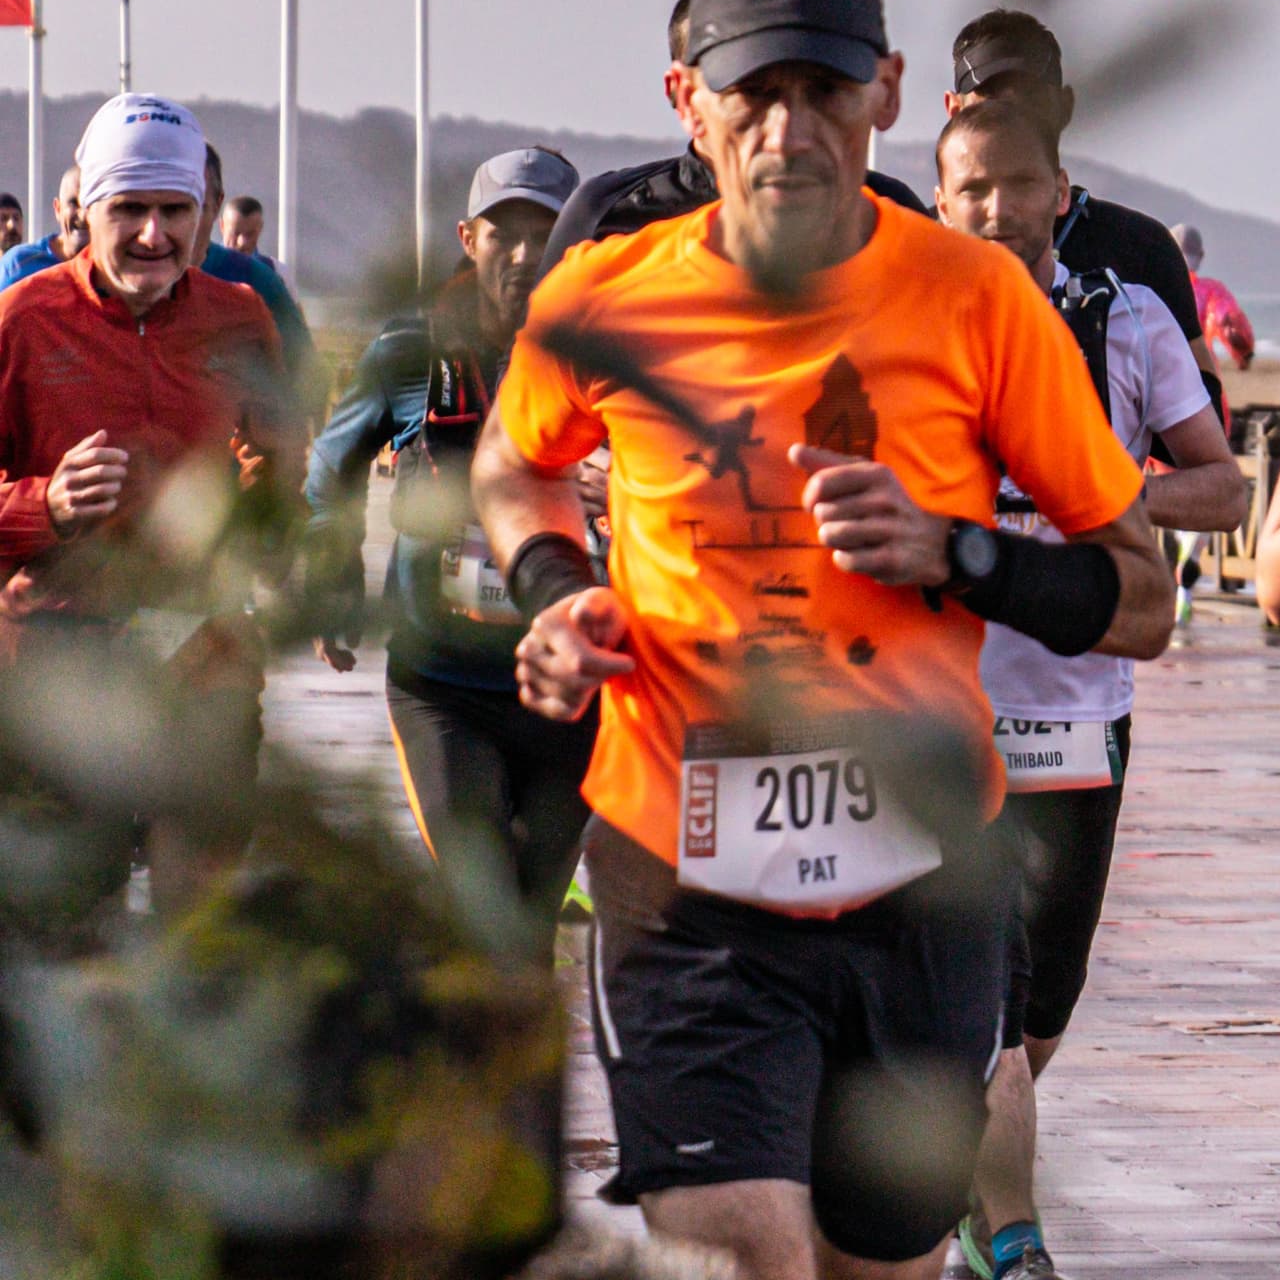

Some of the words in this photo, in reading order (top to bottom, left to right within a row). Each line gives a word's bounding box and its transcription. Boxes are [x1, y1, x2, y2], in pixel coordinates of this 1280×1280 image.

[1007, 751, 1064, 769] THIBAUD
[690, 767, 715, 836] CLIF
[755, 756, 878, 832] 2079
[798, 855, 837, 885] PAT
